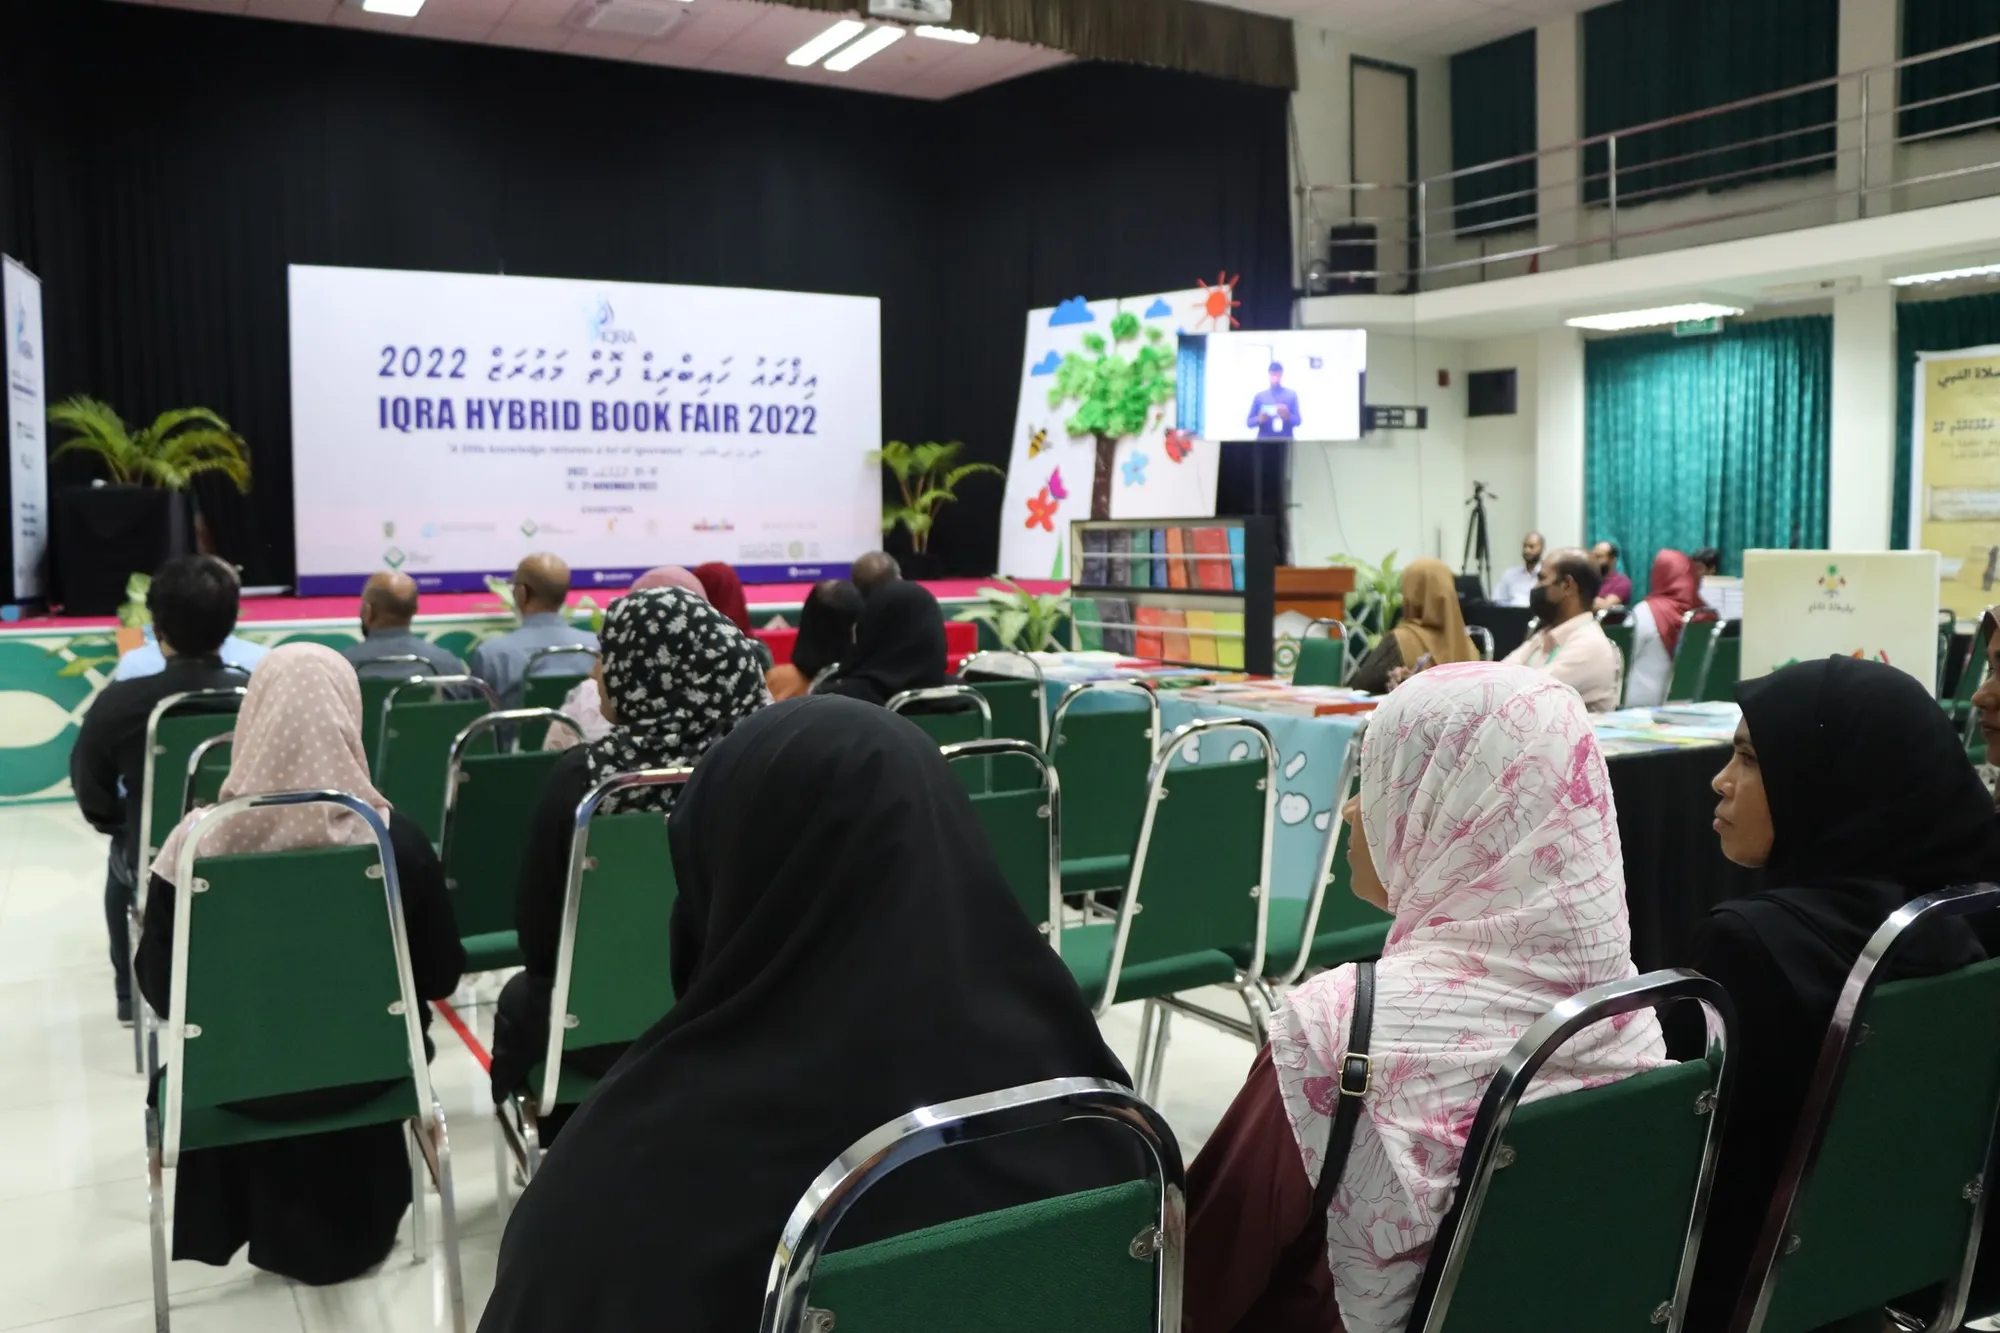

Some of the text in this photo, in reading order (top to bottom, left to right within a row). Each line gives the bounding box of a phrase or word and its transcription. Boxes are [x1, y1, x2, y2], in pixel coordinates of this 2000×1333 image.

[378, 344, 467, 380] 2022
[378, 396, 818, 436] IQRA HYBRID BOOK FAIR 2022
